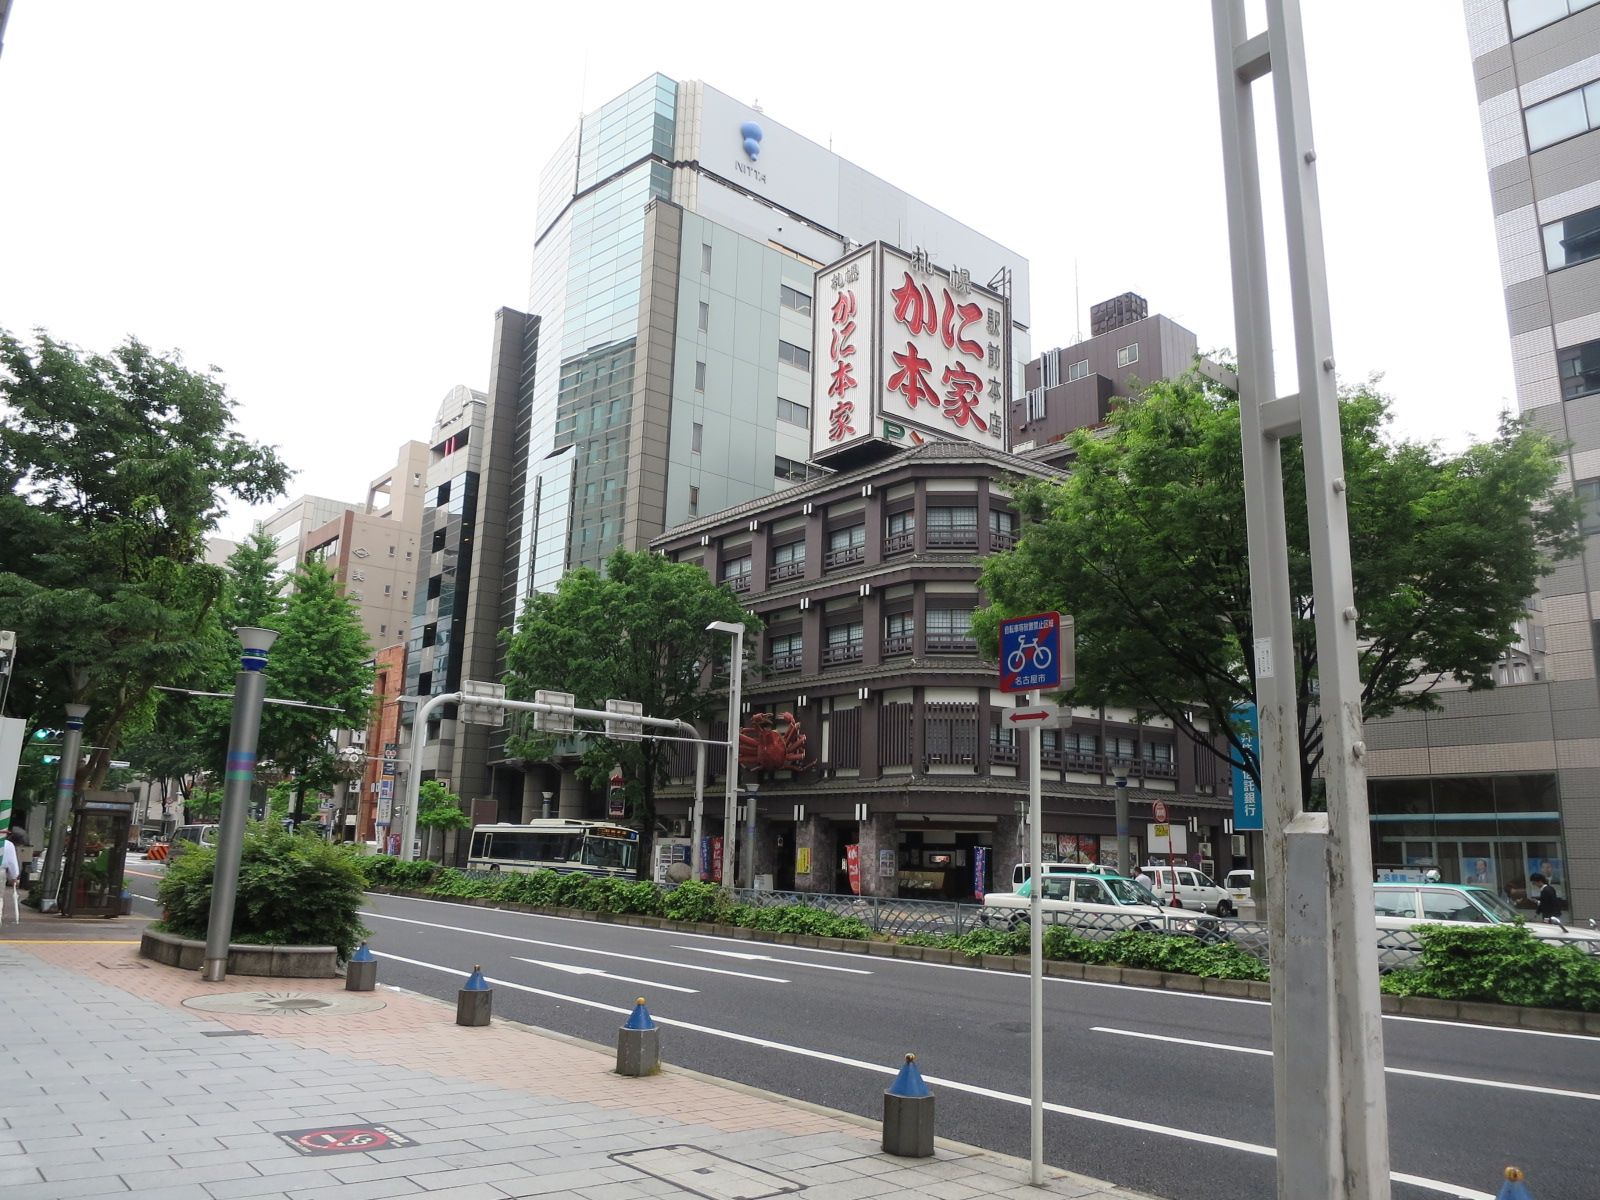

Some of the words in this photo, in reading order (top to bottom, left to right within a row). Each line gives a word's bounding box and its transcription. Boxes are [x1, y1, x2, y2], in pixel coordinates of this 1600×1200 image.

[735, 160, 766, 184] NITTA
[830, 264, 859, 289] 札幌
[910, 245, 971, 296] 札幌
[891, 271, 984, 360] かに
[828, 290, 857, 441] かに本家
[888, 342, 988, 432] 本家
[986, 307, 1001, 438] 駅前本店
[884, 421, 905, 440] P
[1015, 674, 1046, 686] 名古屋市
